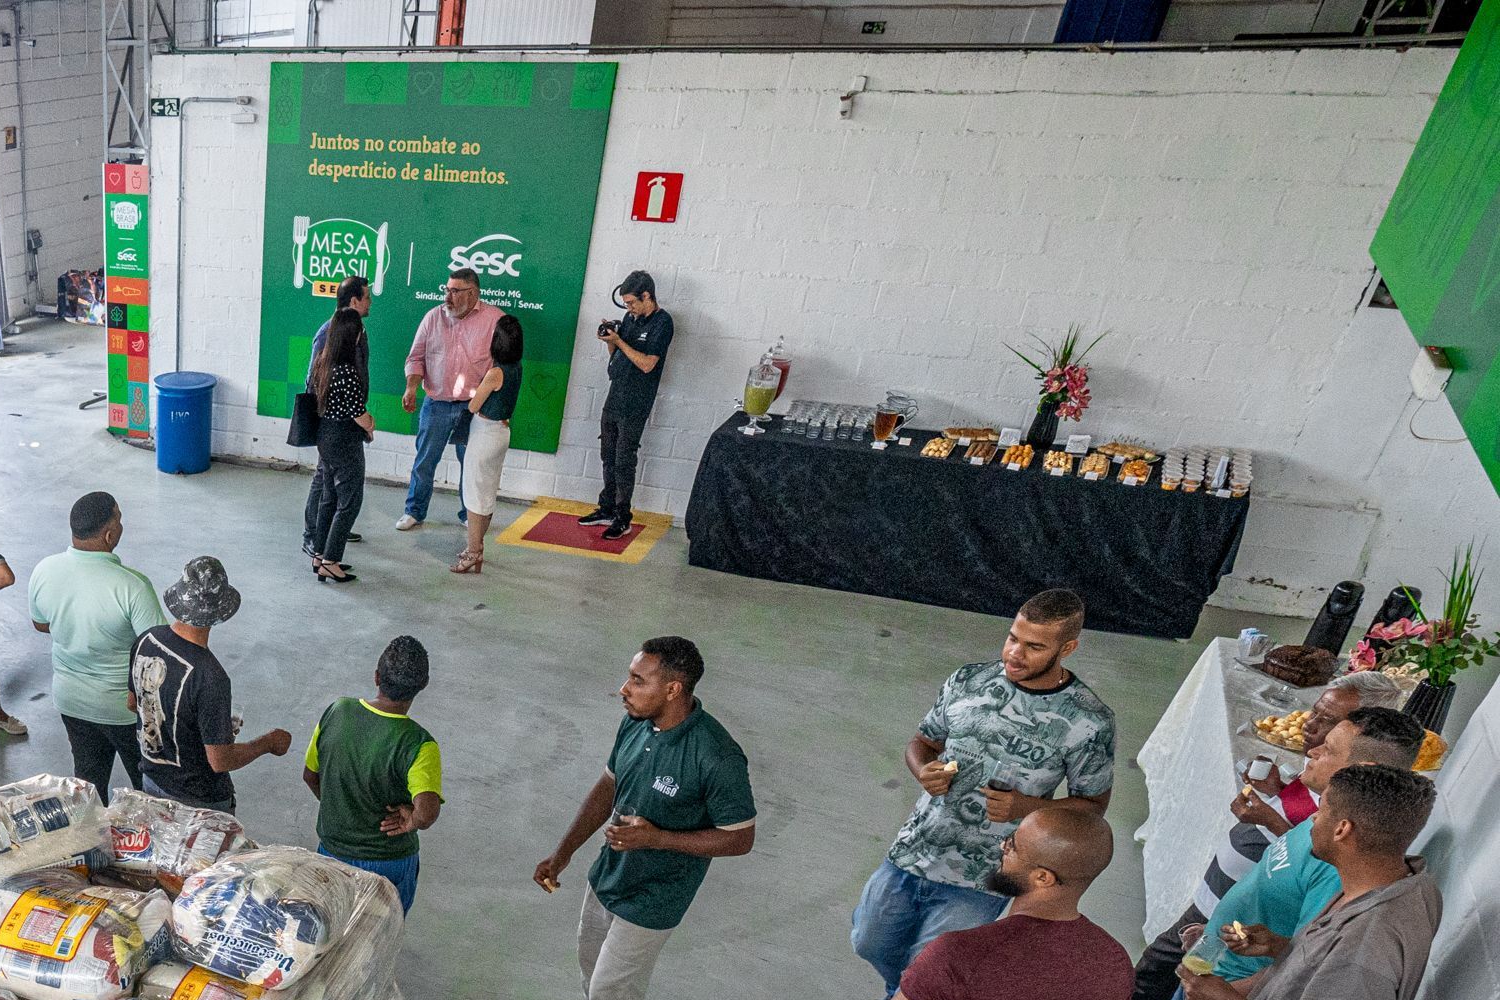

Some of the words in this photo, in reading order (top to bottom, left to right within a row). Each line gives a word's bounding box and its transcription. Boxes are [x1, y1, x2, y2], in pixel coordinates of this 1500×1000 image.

[310, 132, 360, 151] Juntos
[365, 136, 385, 152] no
[389, 135, 457, 155] combate
[461, 142, 481, 156] ao
[308, 159, 397, 182] desperdício
[400, 163, 419, 181] de
[423, 164, 509, 185] alimentos.
[311, 231, 372, 256] MESA
[308, 256, 370, 281] BRASIL
[479, 288, 506, 298] mércio
[507, 289, 522, 299] MG
[518, 300, 544, 311] Senac
[207, 929, 295, 972] Vasconcelos
